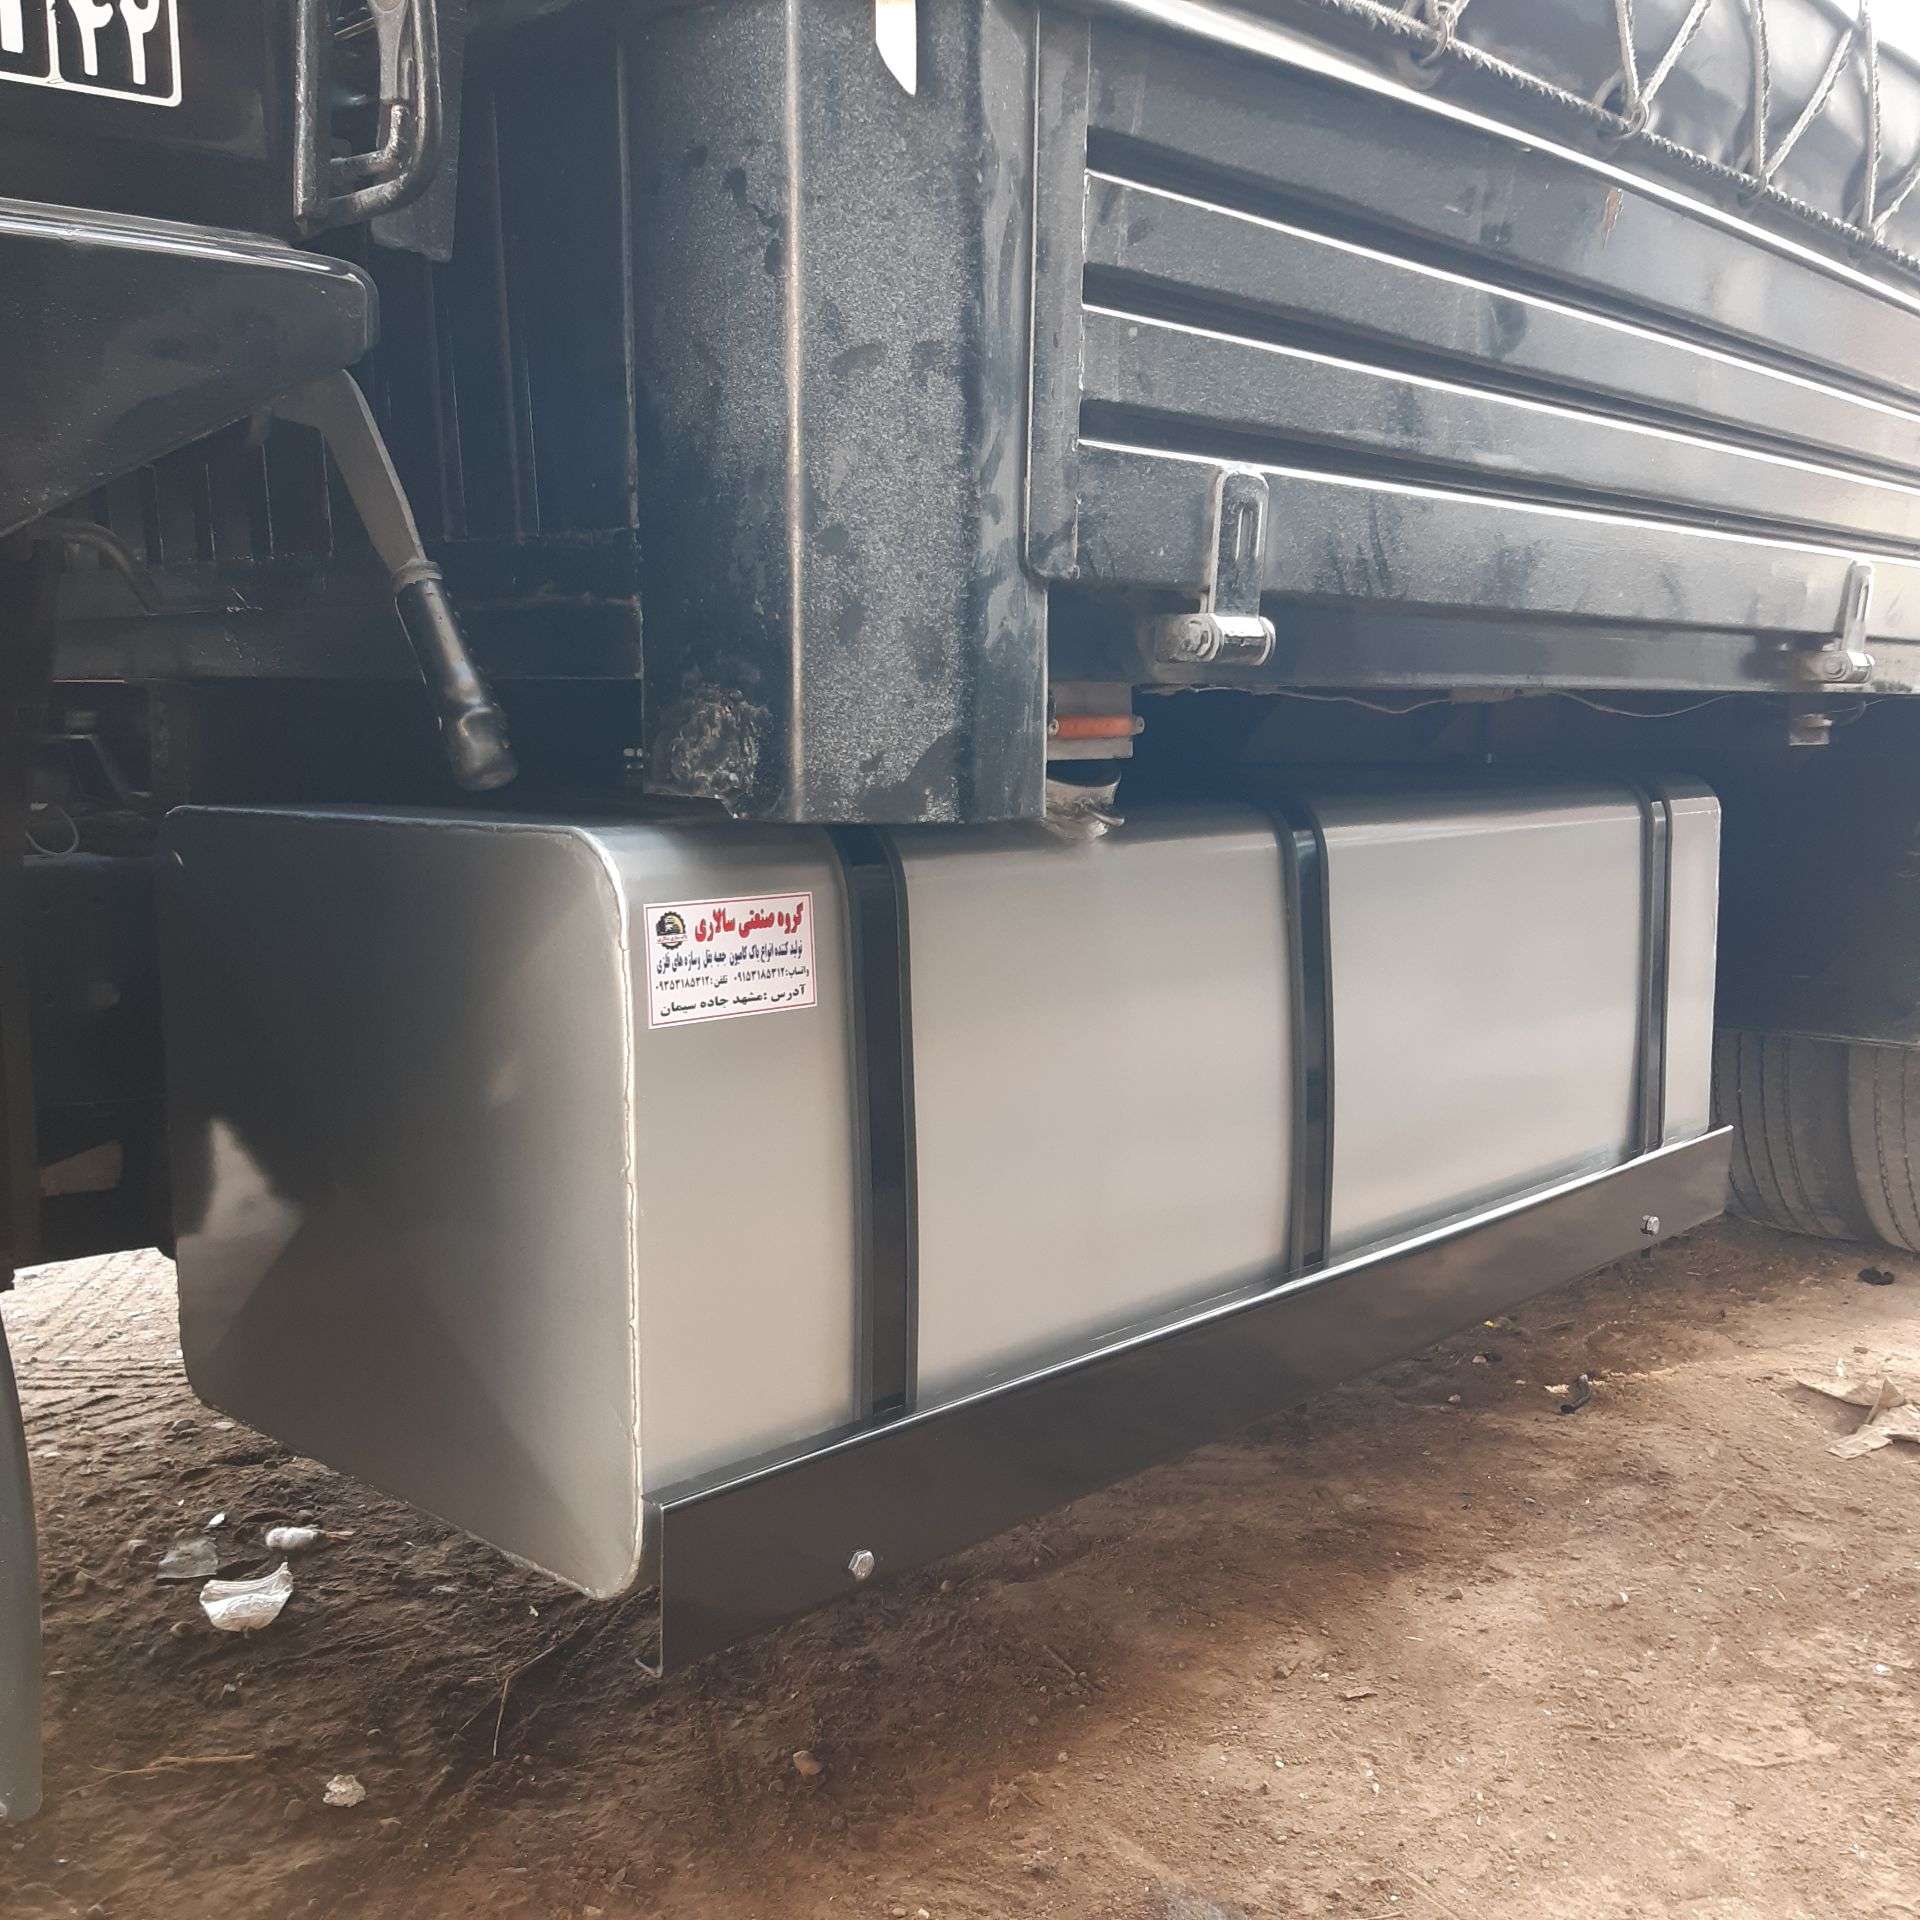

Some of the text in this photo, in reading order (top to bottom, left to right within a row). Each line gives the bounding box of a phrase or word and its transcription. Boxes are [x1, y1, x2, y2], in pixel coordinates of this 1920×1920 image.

[694, 902, 803, 942] گروه صنعتی سالاری
[729, 945, 747, 966] کامیون
[761, 942, 774, 963] انواع
[775, 941, 789, 956] کننده
[790, 939, 803, 959] تولید
[660, 1001, 696, 1017] سیمان
[700, 995, 729, 1008] جاده
